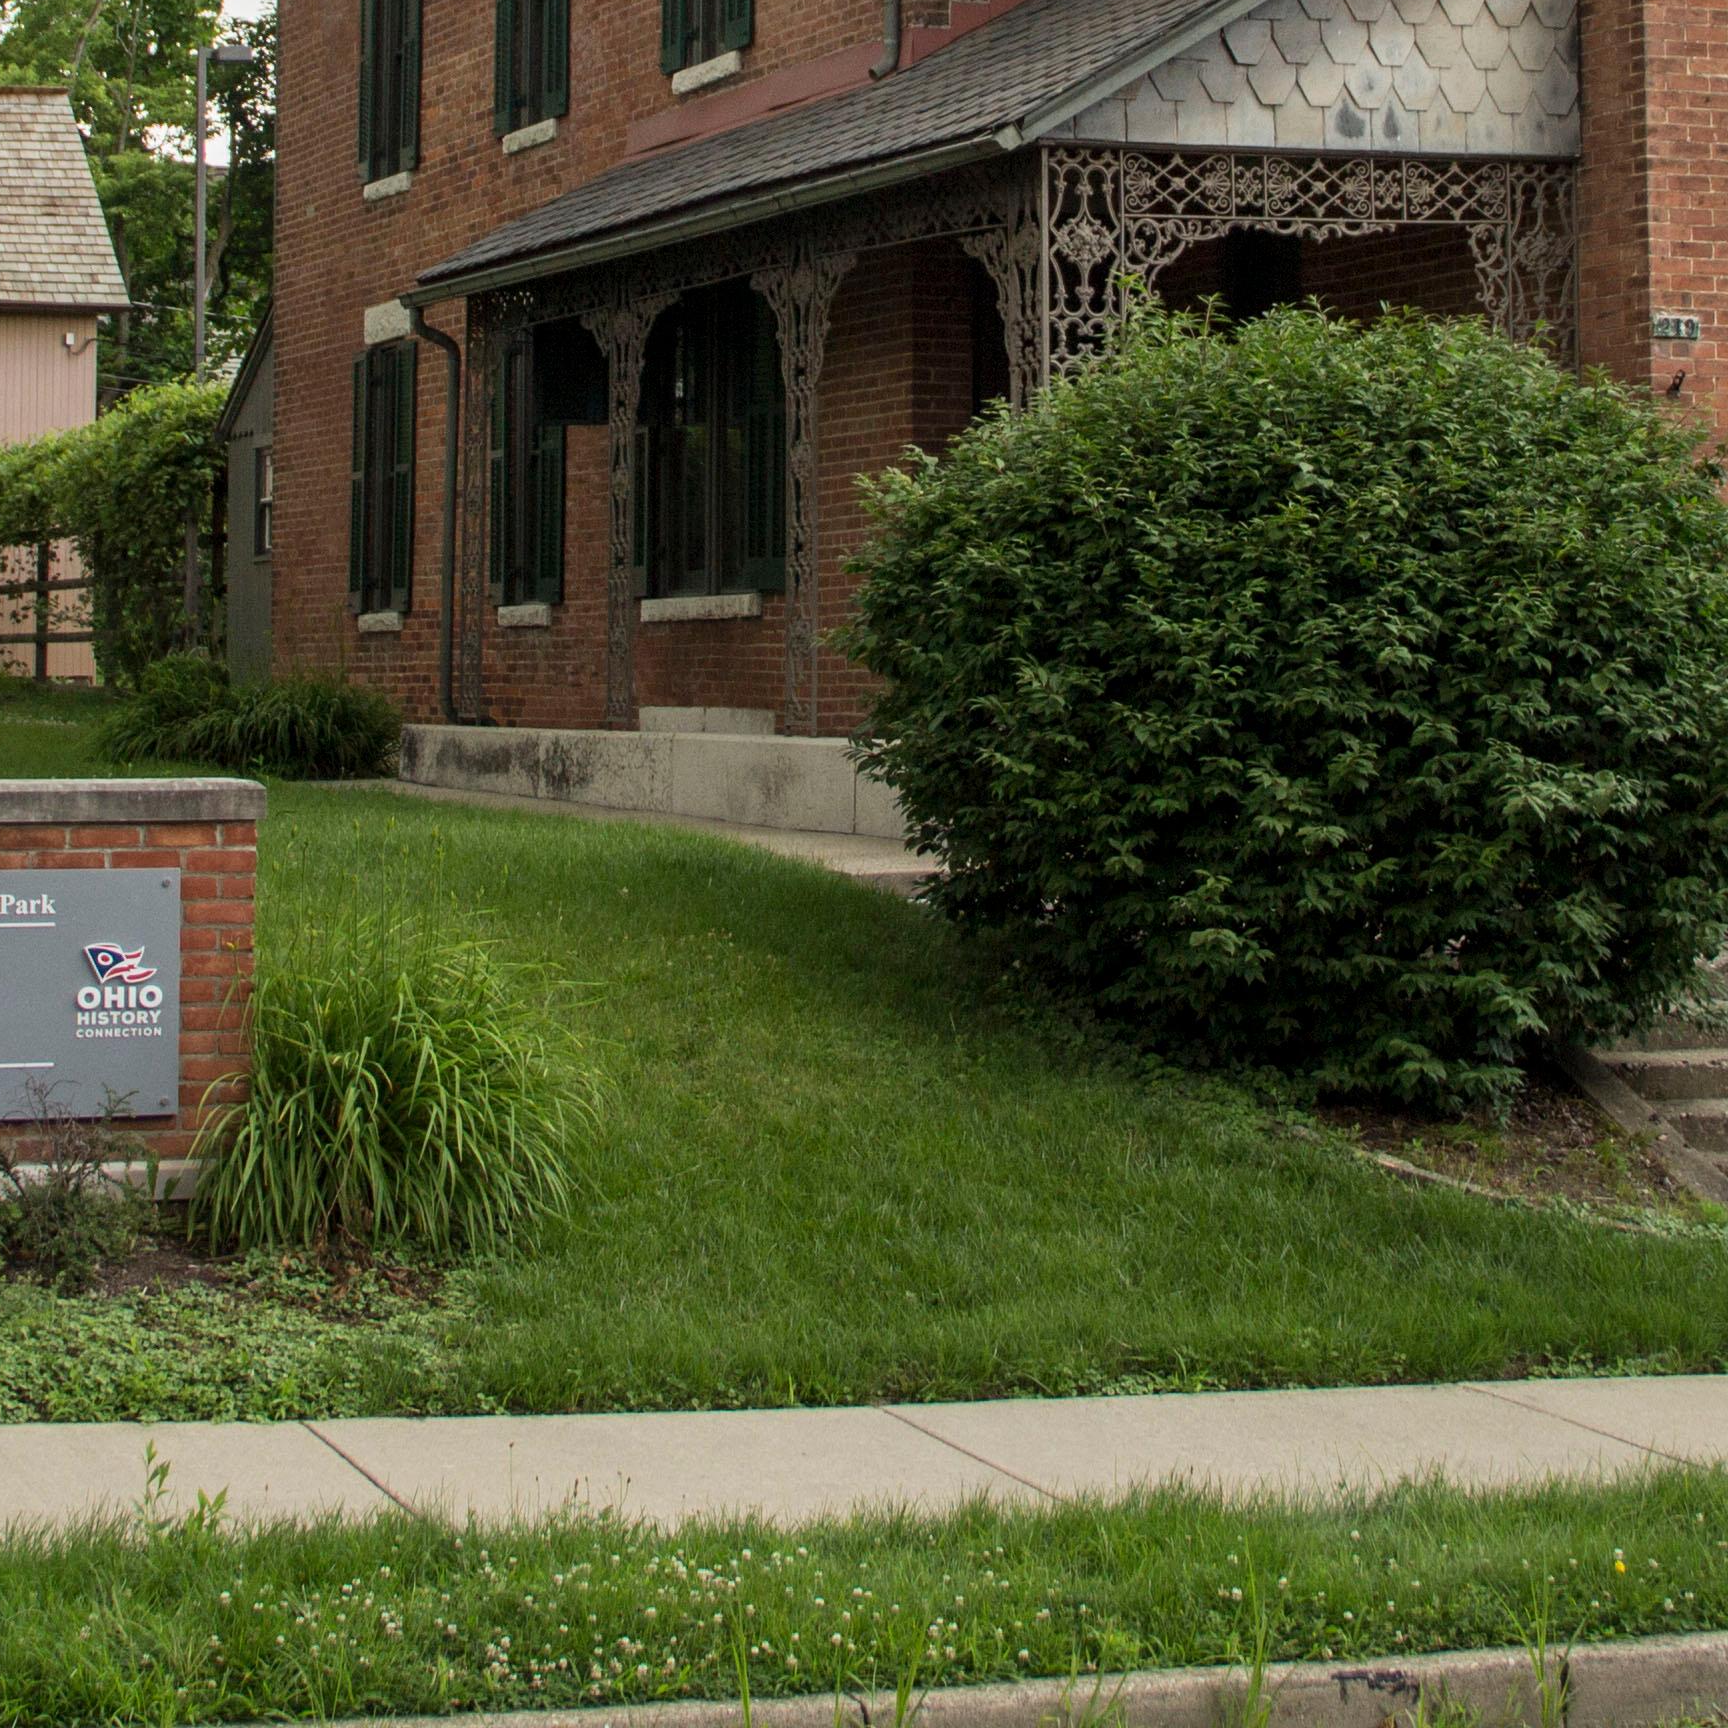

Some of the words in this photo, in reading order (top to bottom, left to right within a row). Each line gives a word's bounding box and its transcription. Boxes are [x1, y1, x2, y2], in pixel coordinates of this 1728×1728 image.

[1657, 318, 1696, 337] 219
[0, 894, 56, 915] Park
[77, 985, 163, 1009] OHIO
[76, 1010, 162, 1025] HISTORY
[76, 1027, 162, 1039] CONNECTION
